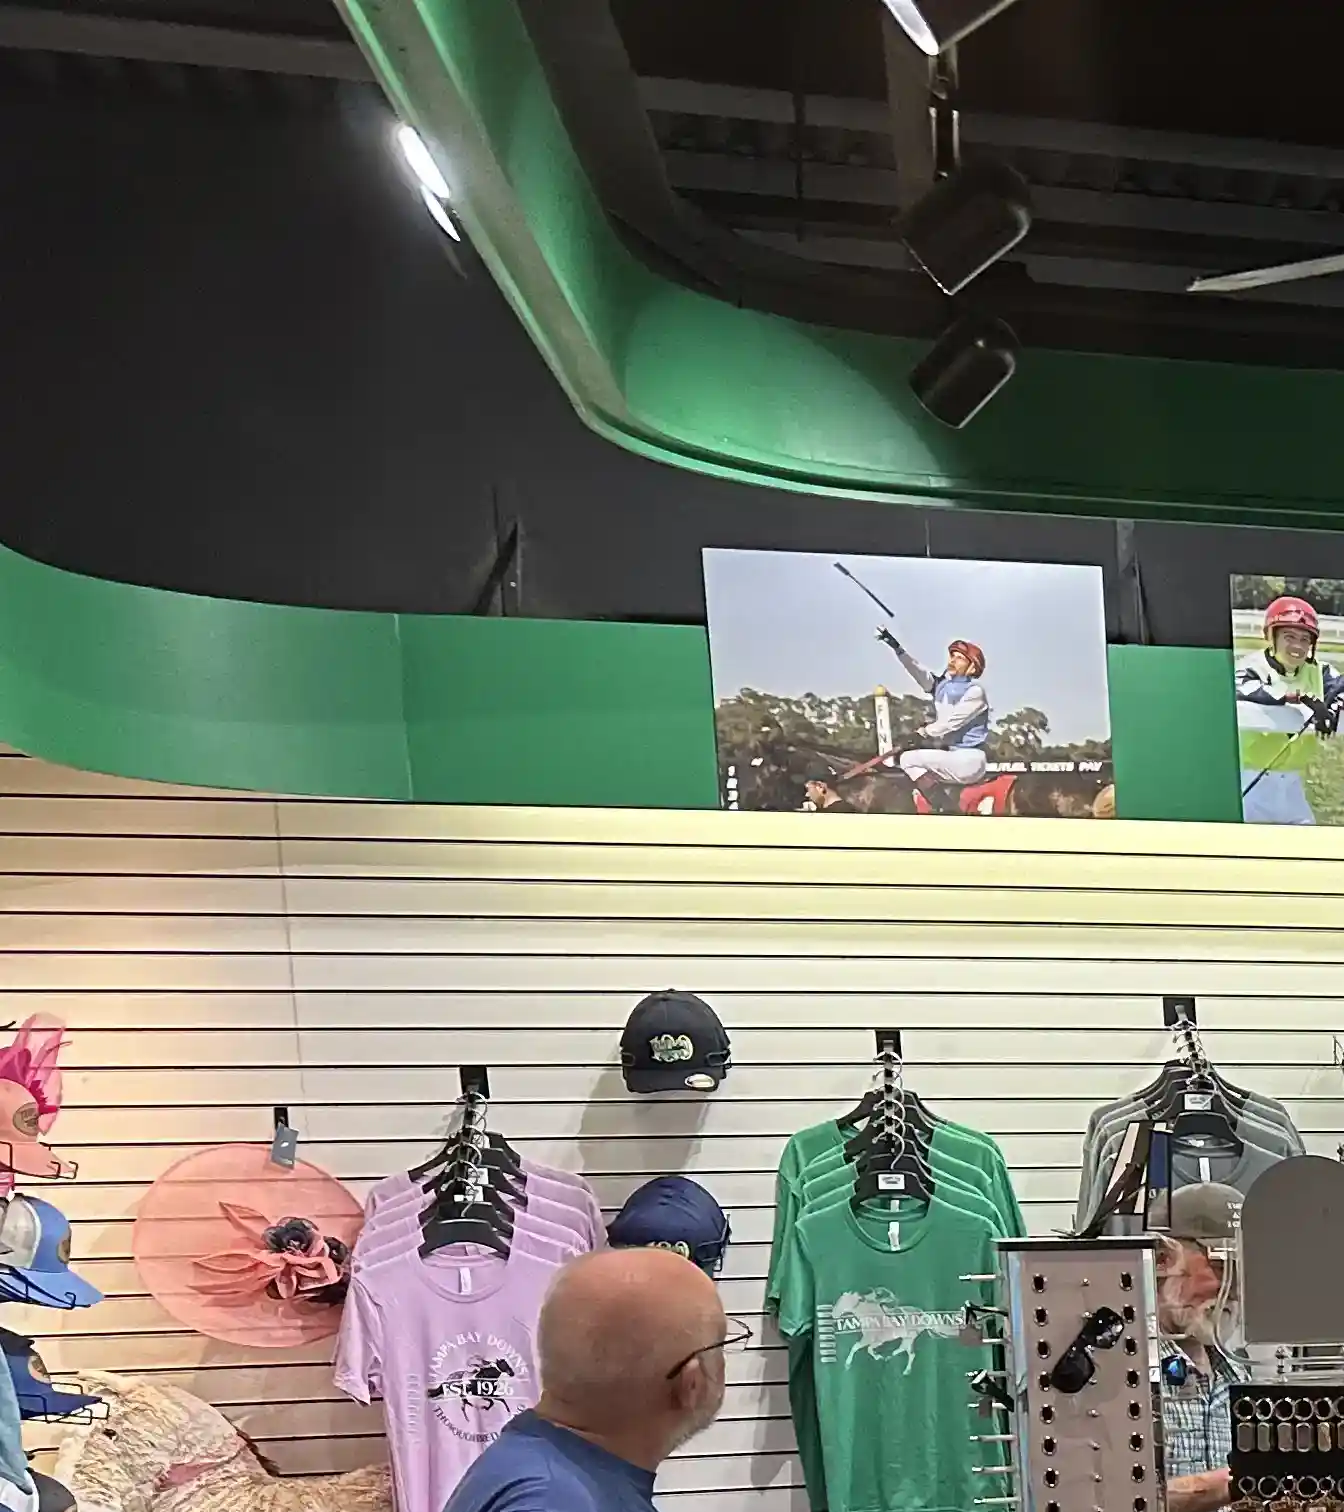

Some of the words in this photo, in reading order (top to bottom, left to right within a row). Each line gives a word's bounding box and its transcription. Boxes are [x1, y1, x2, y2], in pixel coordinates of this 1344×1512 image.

[1031, 762, 1075, 772] TICKETS
[1079, 761, 1103, 772] PAY
[836, 1315, 881, 1331] TAMPA
[911, 1313, 964, 1326] DOWNS
[428, 1340, 457, 1379] TAMPA
[456, 1331, 482, 1346] BAY
[487, 1334, 529, 1377] DOWNS
[442, 1383, 472, 1397] EST.
[477, 1381, 514, 1397] 1926
